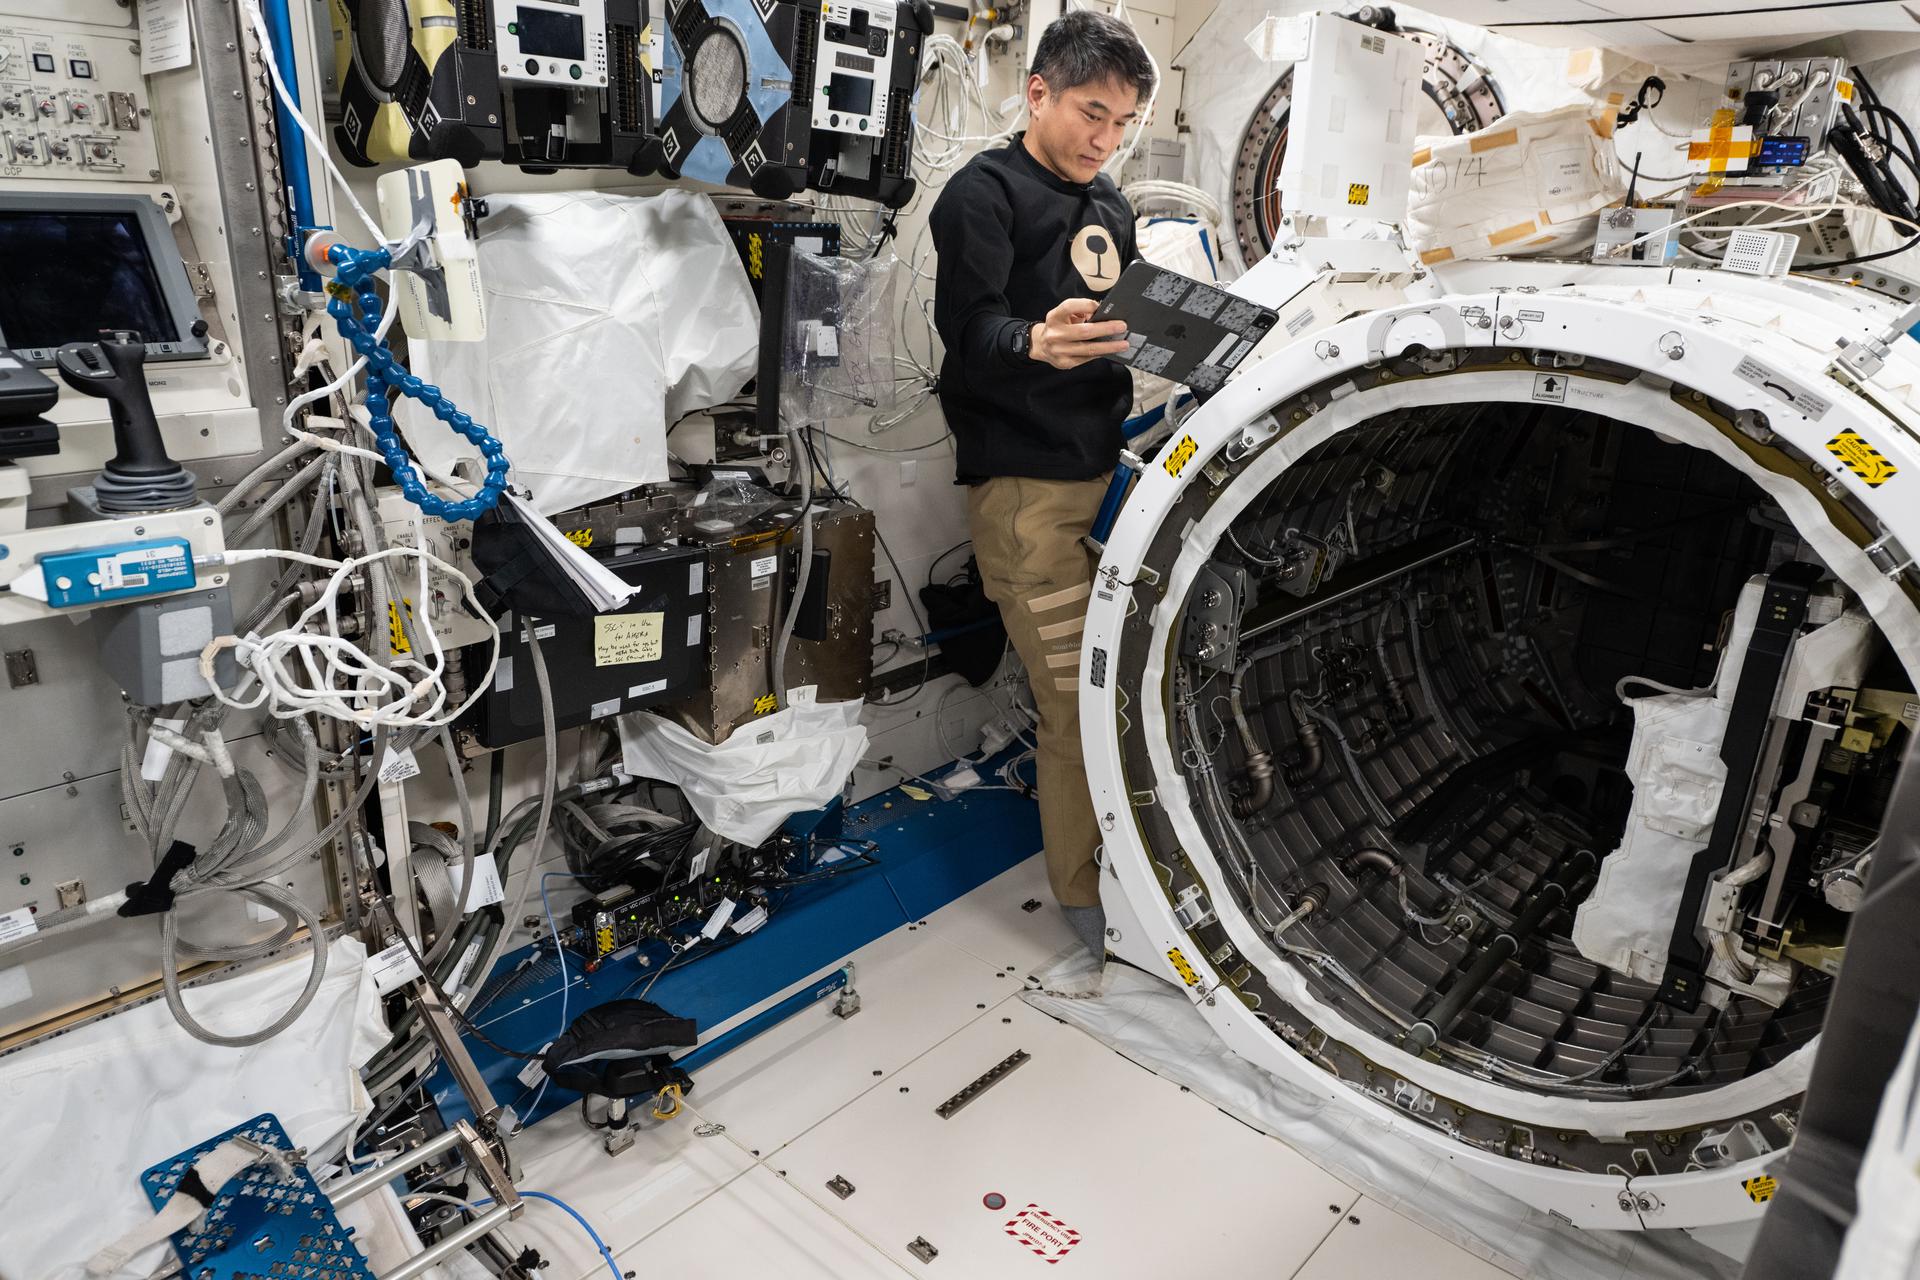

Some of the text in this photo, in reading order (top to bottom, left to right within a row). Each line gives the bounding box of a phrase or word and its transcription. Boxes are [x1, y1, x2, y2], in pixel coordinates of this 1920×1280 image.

[4, 167, 22, 176] CCP
[1570, 388, 1605, 399] STRUCTURE
[1845, 437, 1868, 458] CAUTION
[1022, 1218, 1063, 1248] FIRE PORT
[1030, 1210, 1072, 1241] EMERGENCY USE
